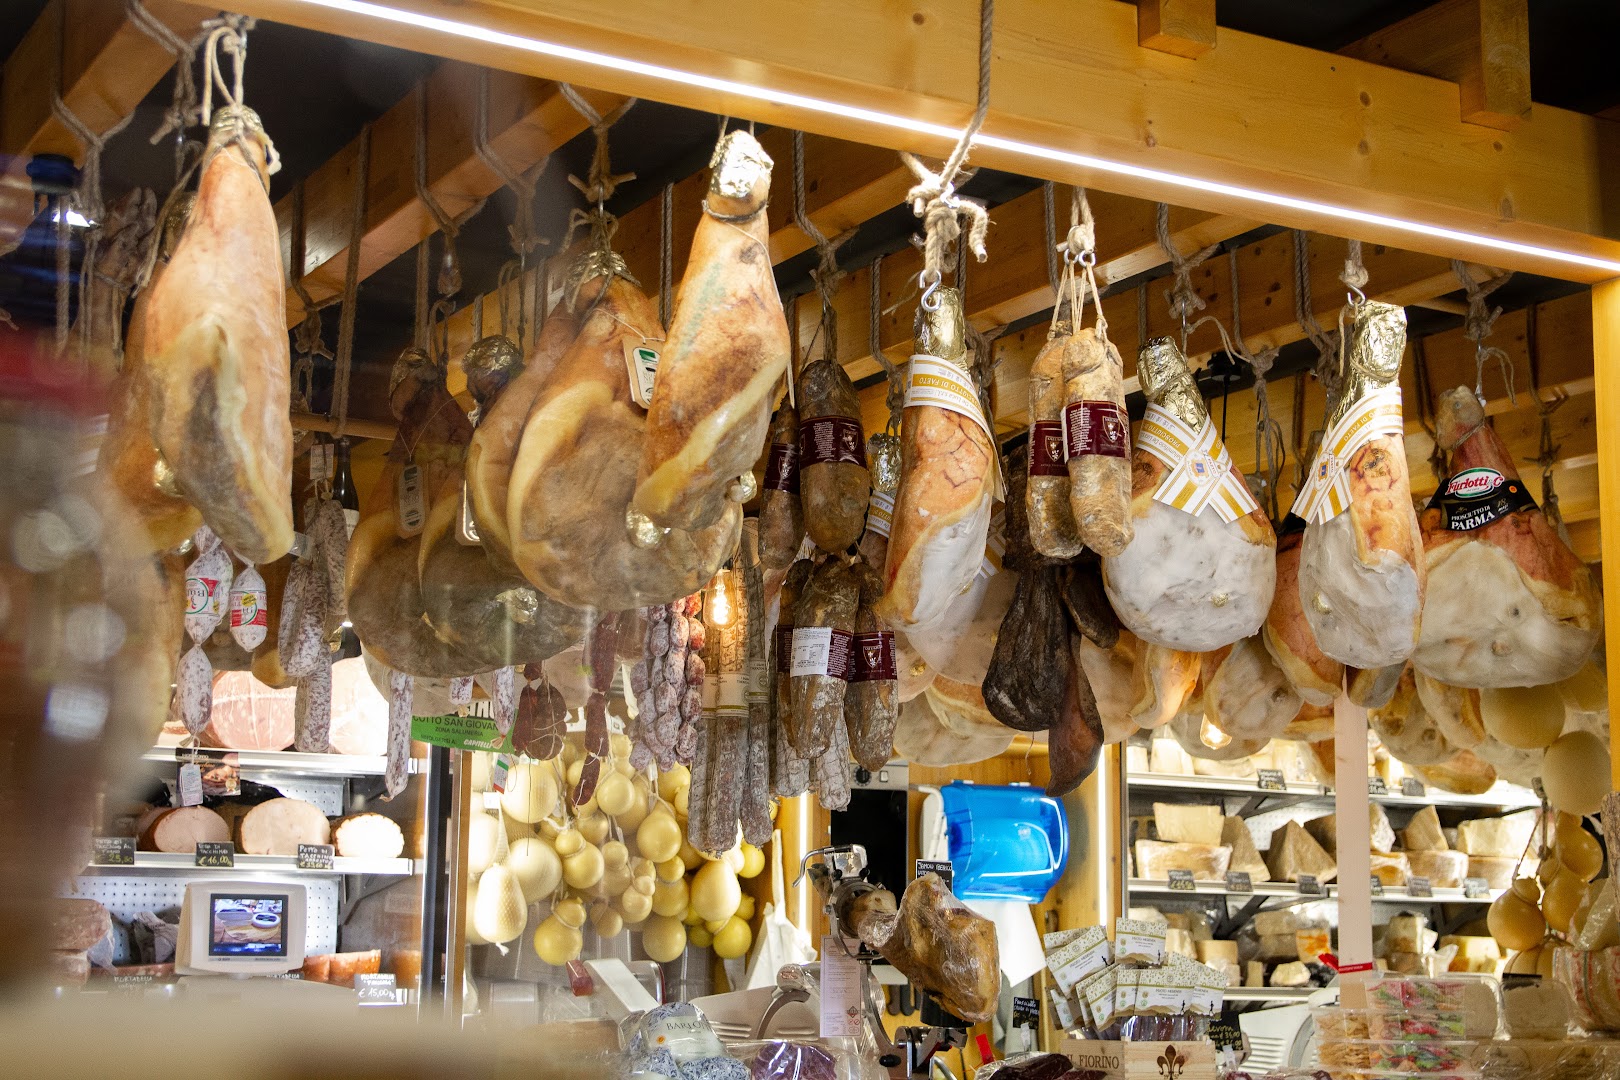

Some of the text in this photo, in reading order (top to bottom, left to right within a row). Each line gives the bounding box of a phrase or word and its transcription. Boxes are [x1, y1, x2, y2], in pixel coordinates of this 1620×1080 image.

[919, 378, 940, 386] FAETO
[941, 380, 949, 388] DI
[1445, 475, 1490, 495] Furlotti
[1451, 507, 1485, 521] PROSCIUTTO
[1451, 510, 1496, 531] PARMA
[444, 717, 464, 727] SAN
[451, 729, 484, 737] SALUMERIA
[463, 739, 493, 749] CAPITELLI
[368, 987, 389, 998] 15,00
[1079, 1054, 1120, 1070] FIORINO
